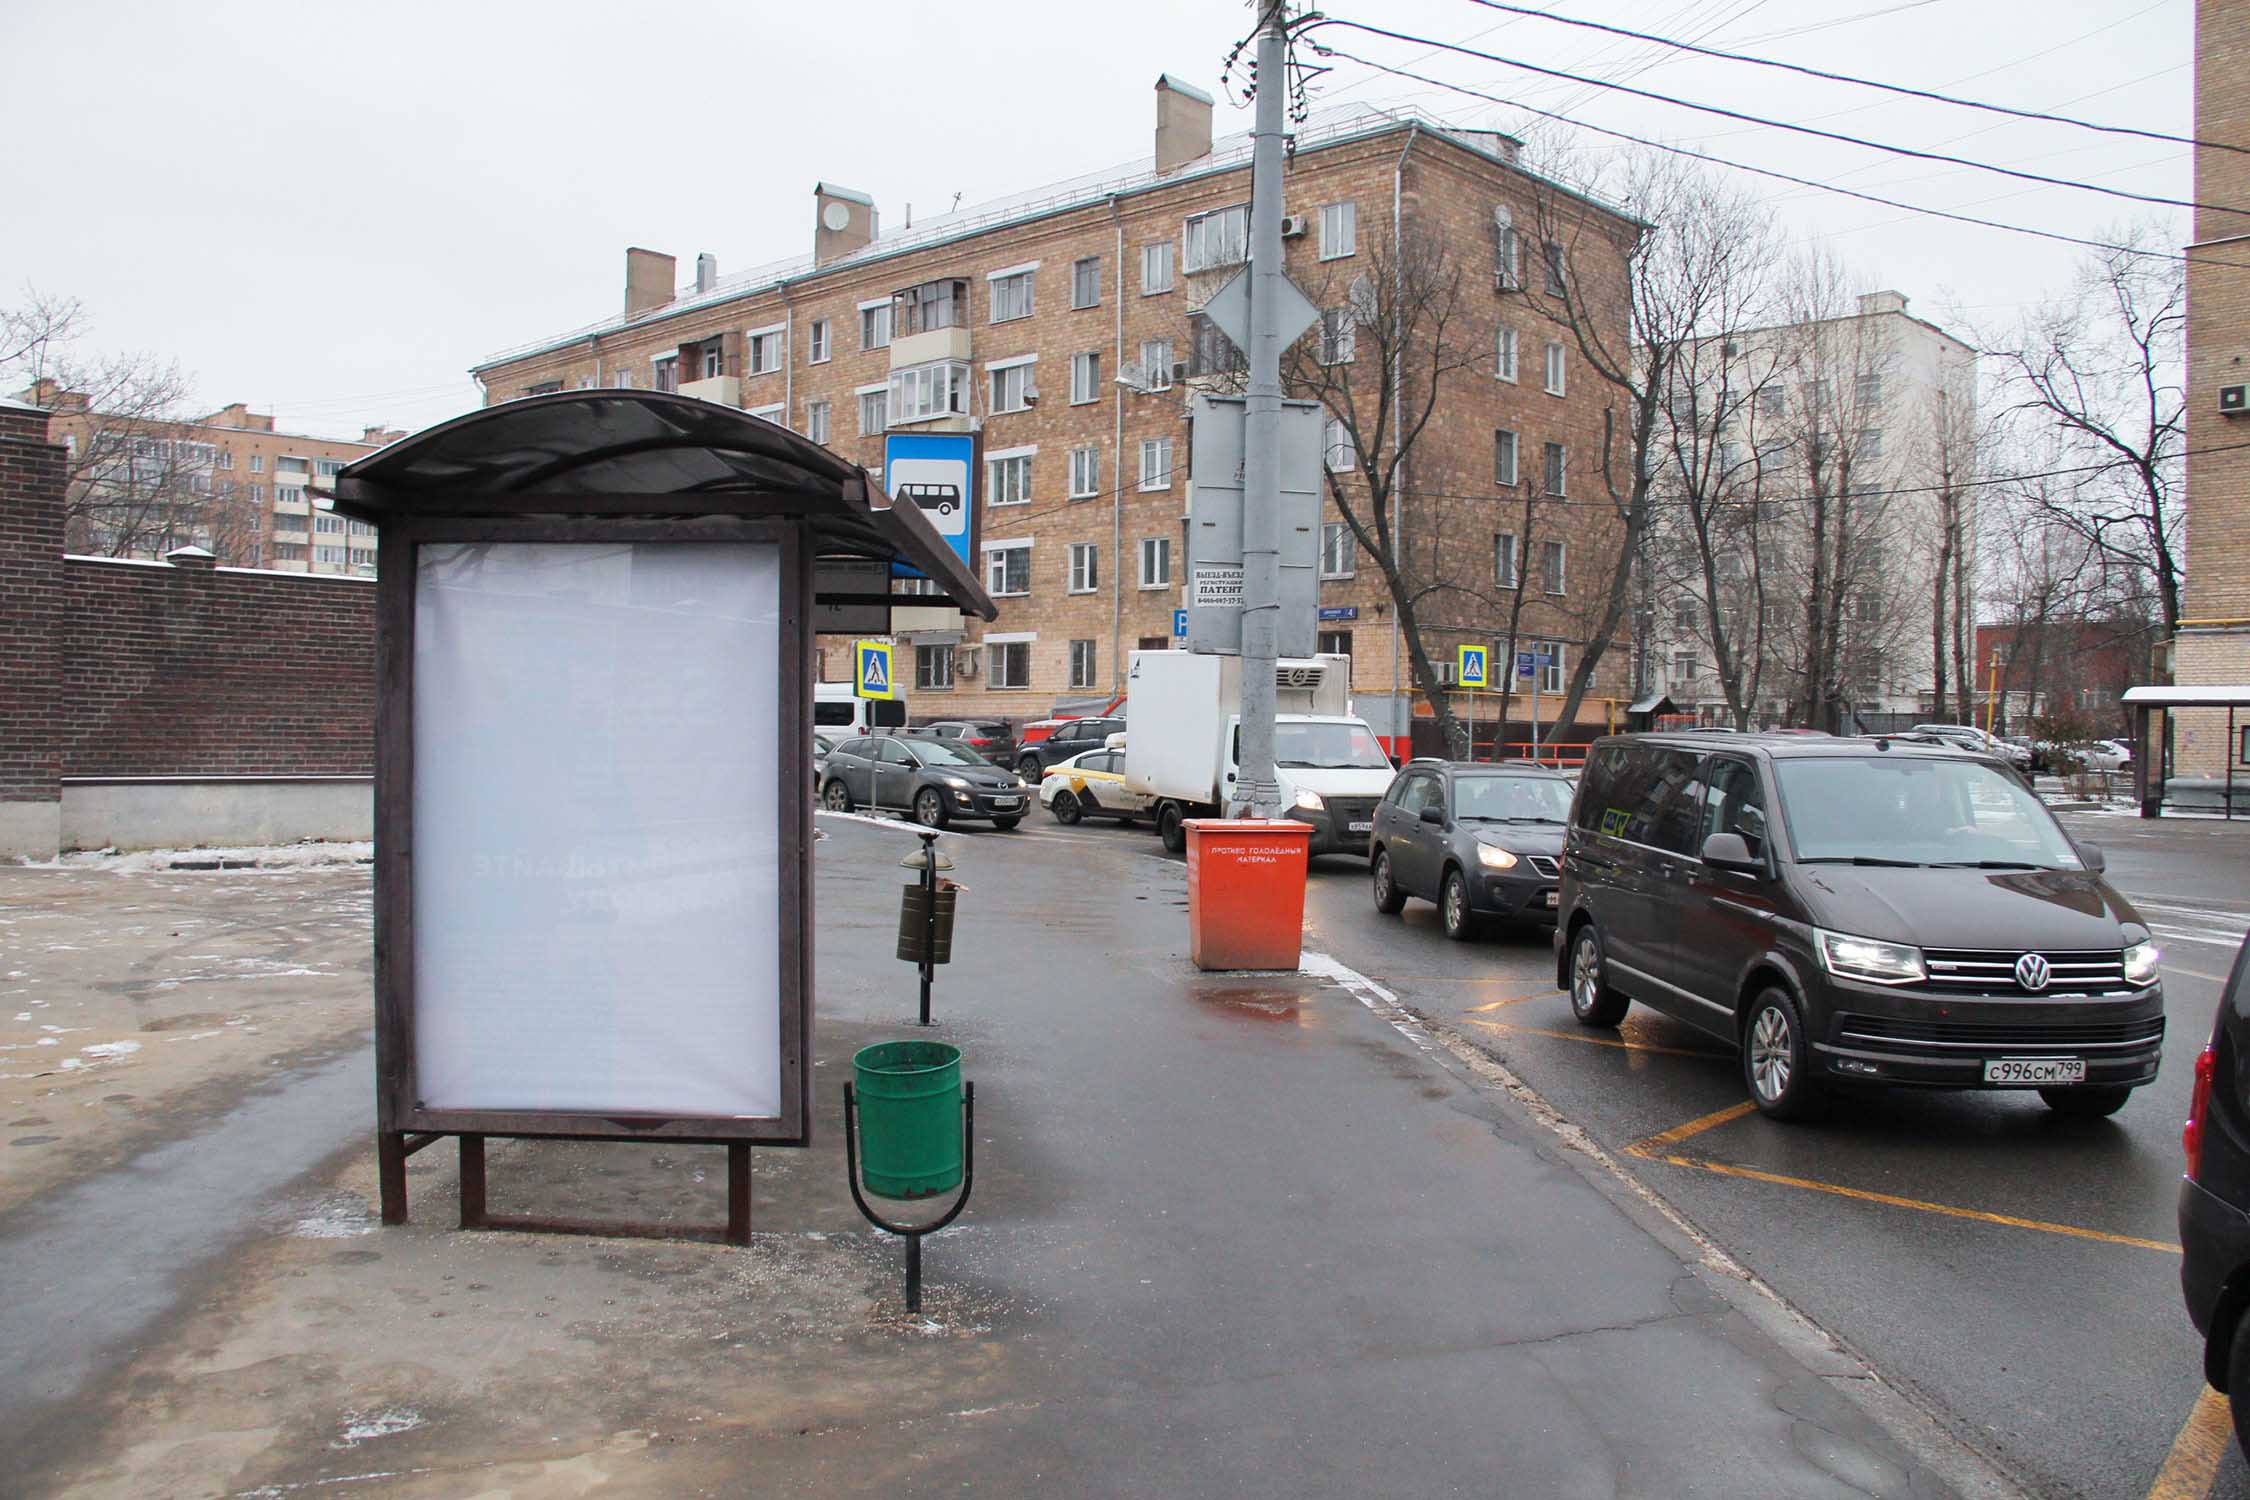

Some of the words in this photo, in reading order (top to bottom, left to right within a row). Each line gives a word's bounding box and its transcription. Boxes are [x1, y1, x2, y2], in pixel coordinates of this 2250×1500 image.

[1199, 586, 1243, 594] ПАТЕНТ
[1211, 847, 1246, 855] ПРОТИВО
[1990, 1063, 2055, 1080] С996СМ
[2058, 1062, 2082, 1075] 799
